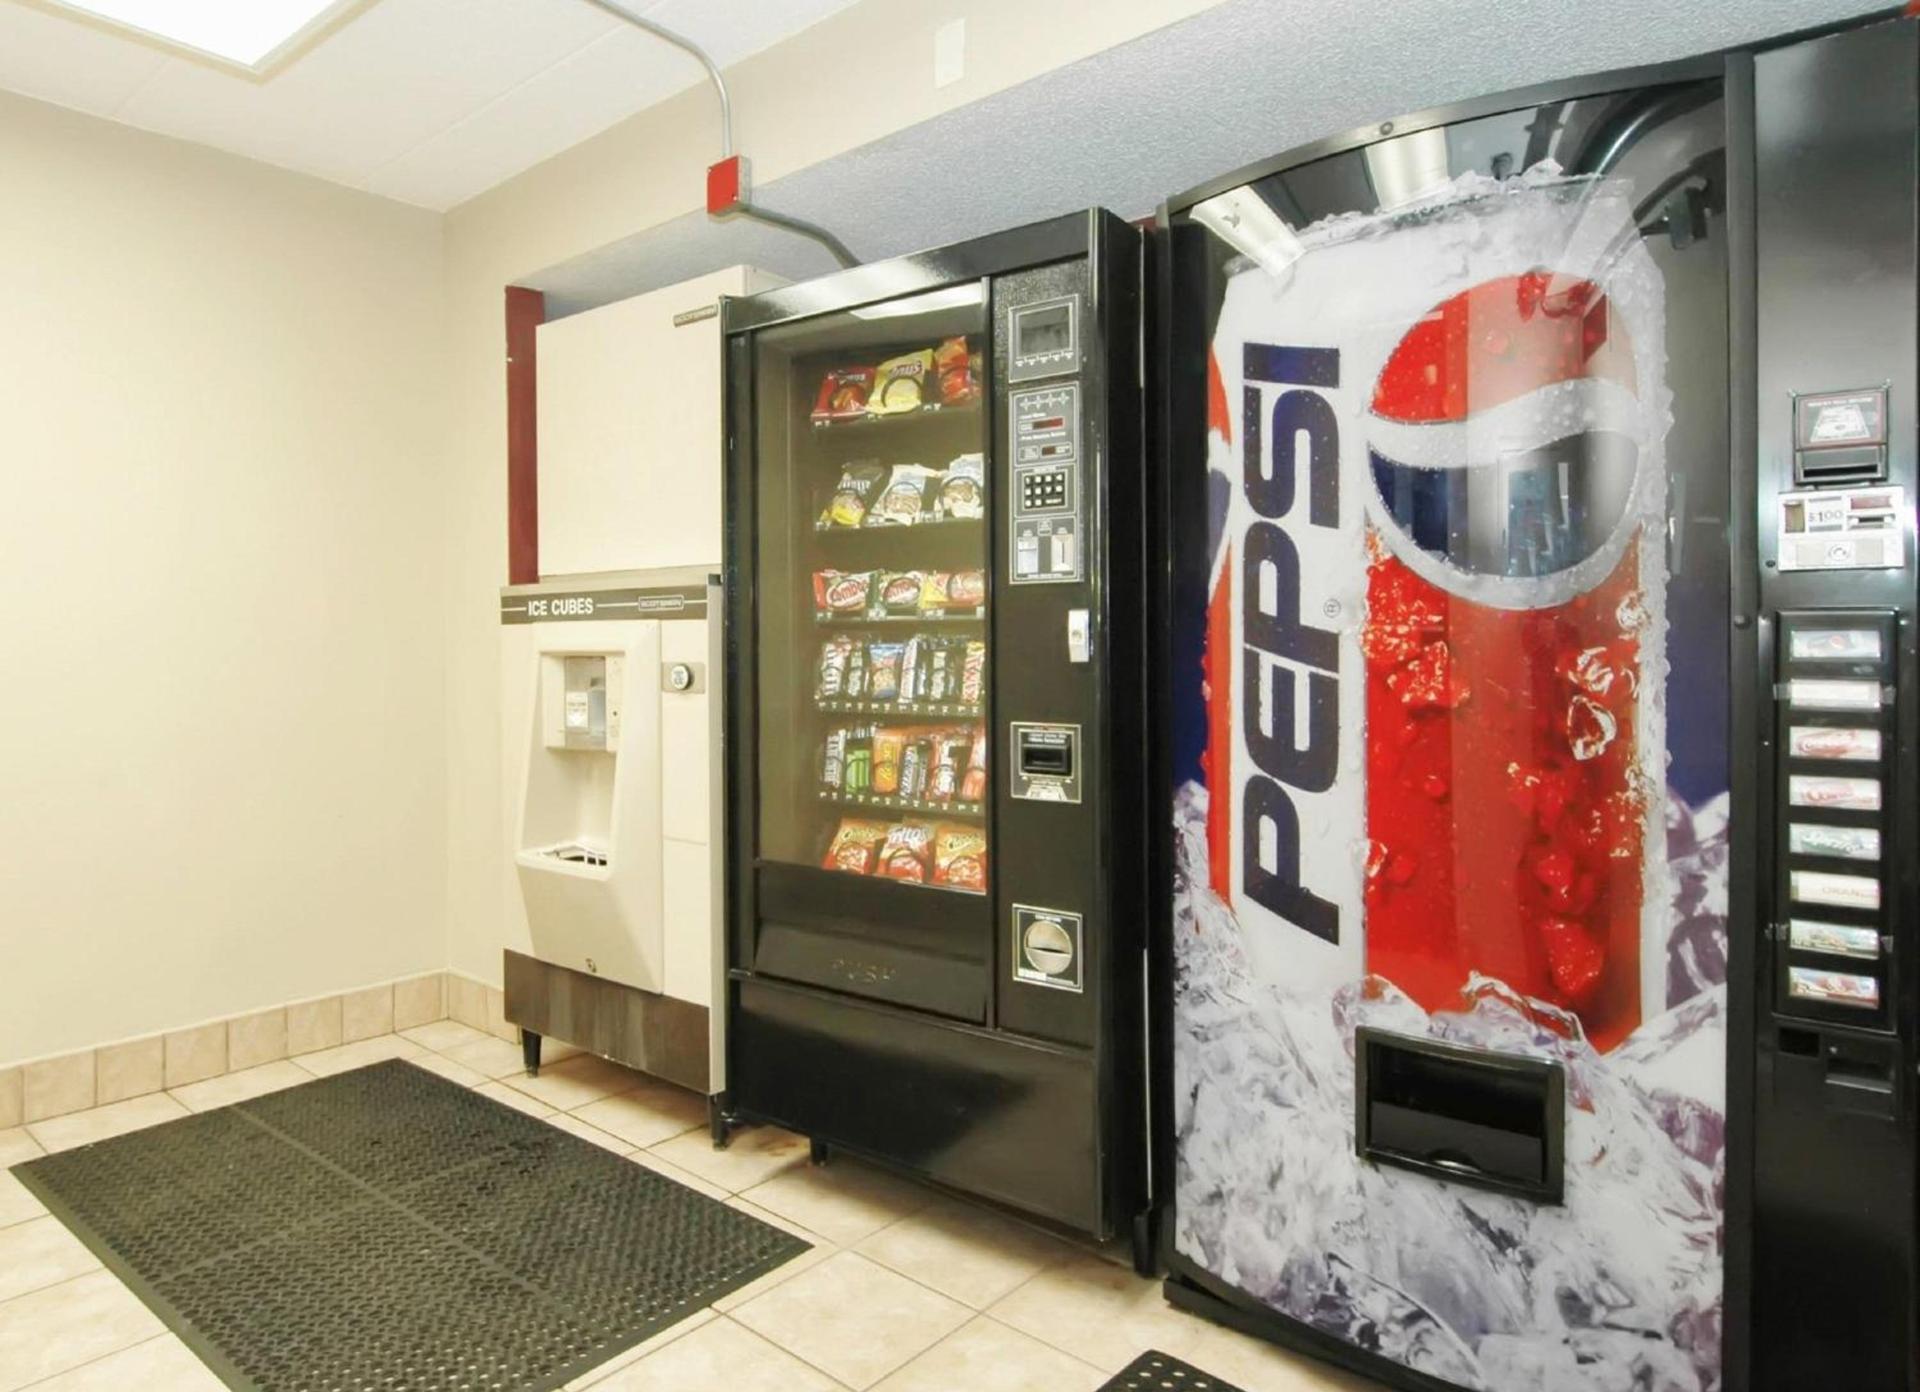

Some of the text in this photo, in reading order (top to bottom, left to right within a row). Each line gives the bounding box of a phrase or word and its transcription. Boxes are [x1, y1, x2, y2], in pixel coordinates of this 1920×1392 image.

[528, 597, 593, 616] ICE CUBES
[1243, 341, 1340, 947] PEPSI
